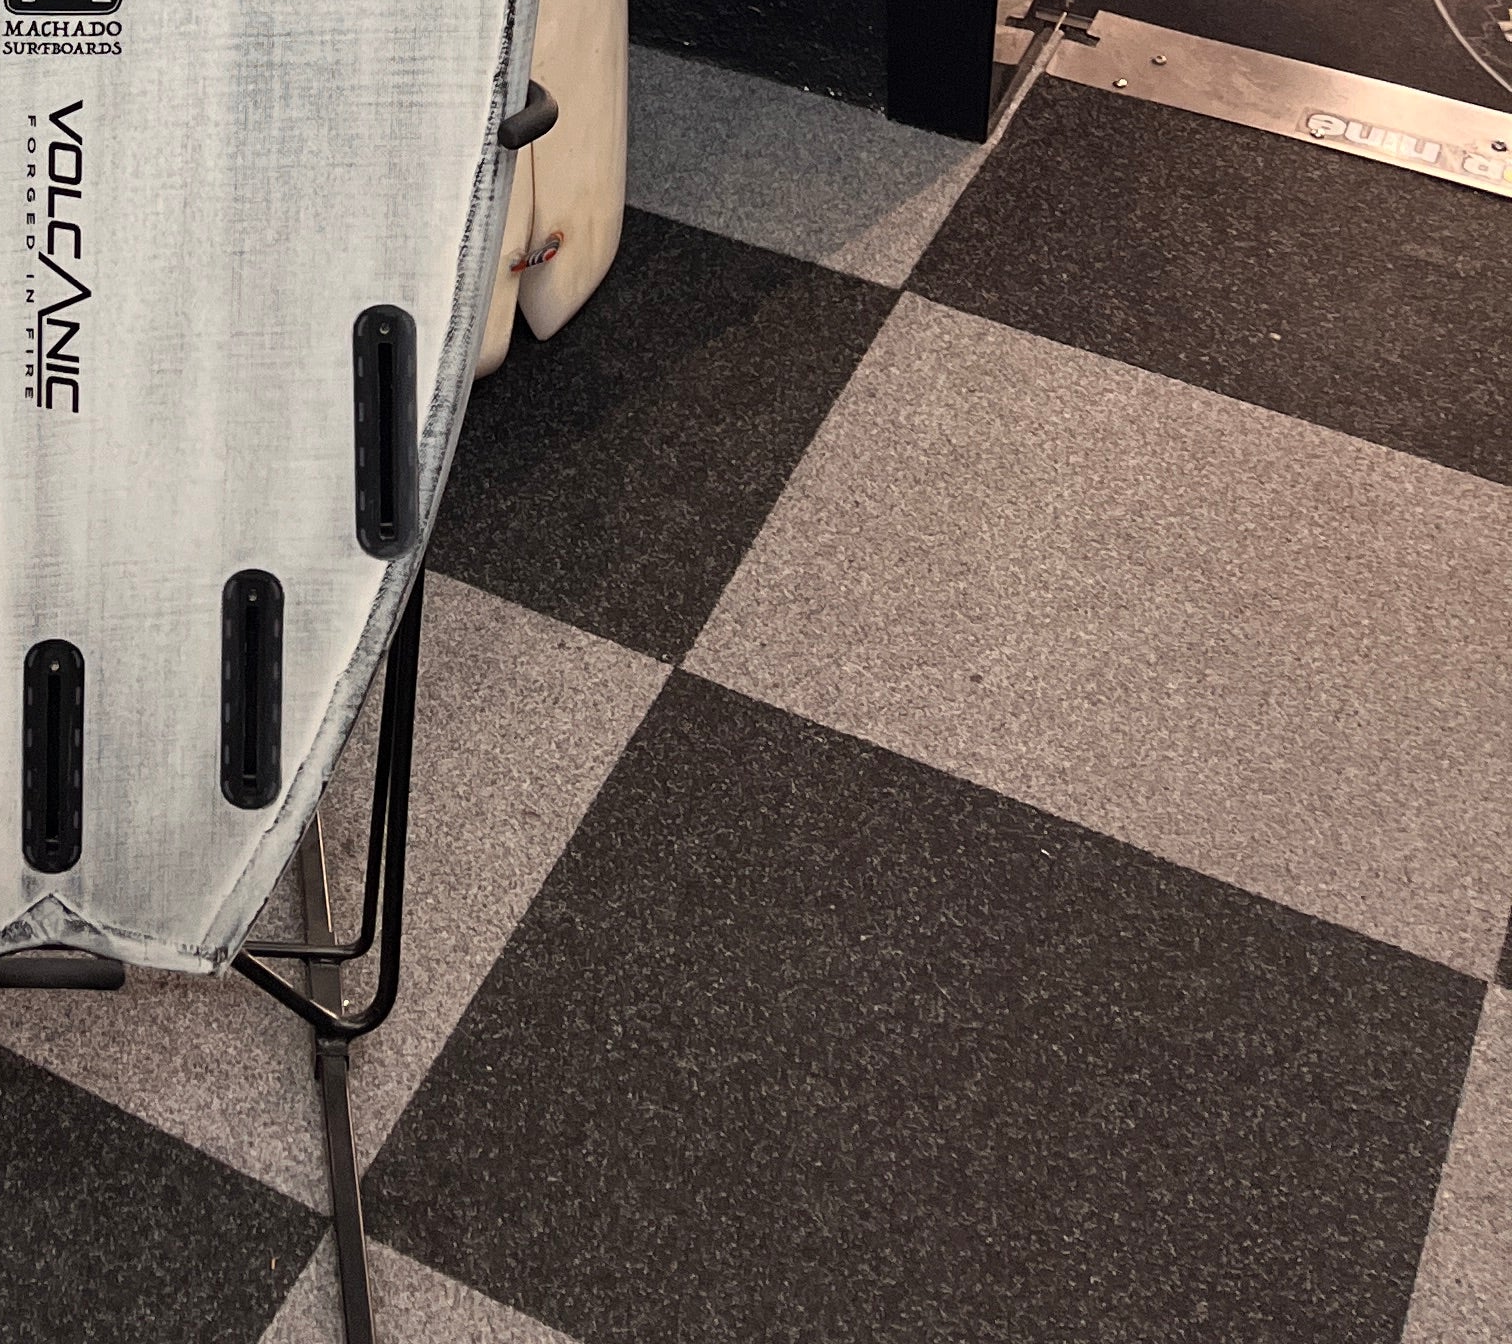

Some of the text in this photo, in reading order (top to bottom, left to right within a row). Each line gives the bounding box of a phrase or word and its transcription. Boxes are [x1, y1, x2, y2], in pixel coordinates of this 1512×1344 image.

[2, 20, 123, 37] MACHADO
[2, 41, 123, 56] SURFBOARDS
[24, 114, 38, 400] FORGED IN FIRE
[38, 99, 92, 414] VOLCANIC
